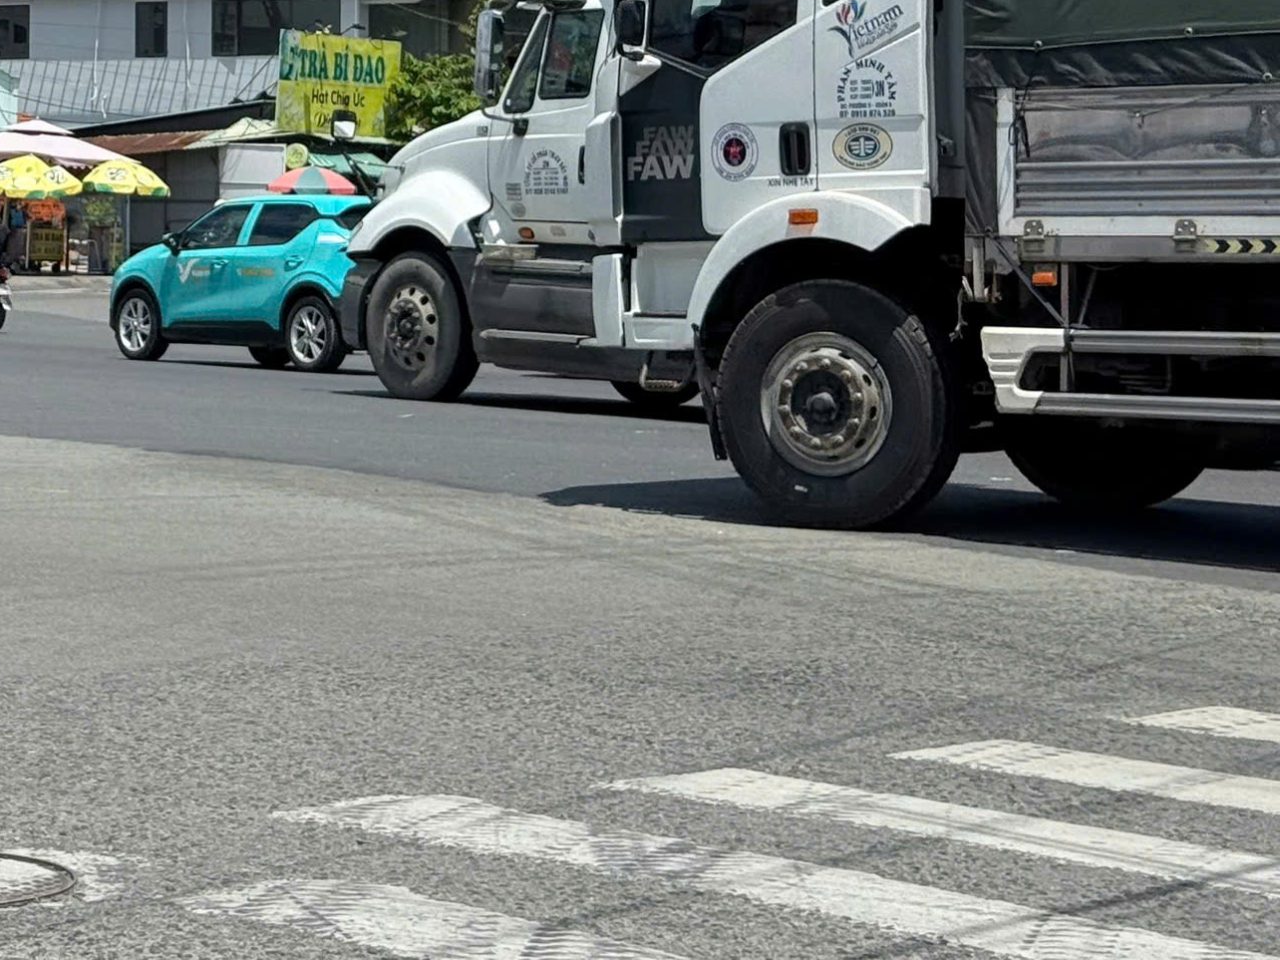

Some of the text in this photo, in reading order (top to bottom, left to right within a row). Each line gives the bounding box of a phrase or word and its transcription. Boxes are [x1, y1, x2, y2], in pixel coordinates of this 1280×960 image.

[299, 42, 385, 84] TRÀ BÍ ĐAO
[855, 58, 885, 73] MINH
[330, 90, 350, 106] Chia
[642, 125, 694, 141] FAW
[635, 140, 694, 157] FAW
[627, 154, 695, 181] FAW
